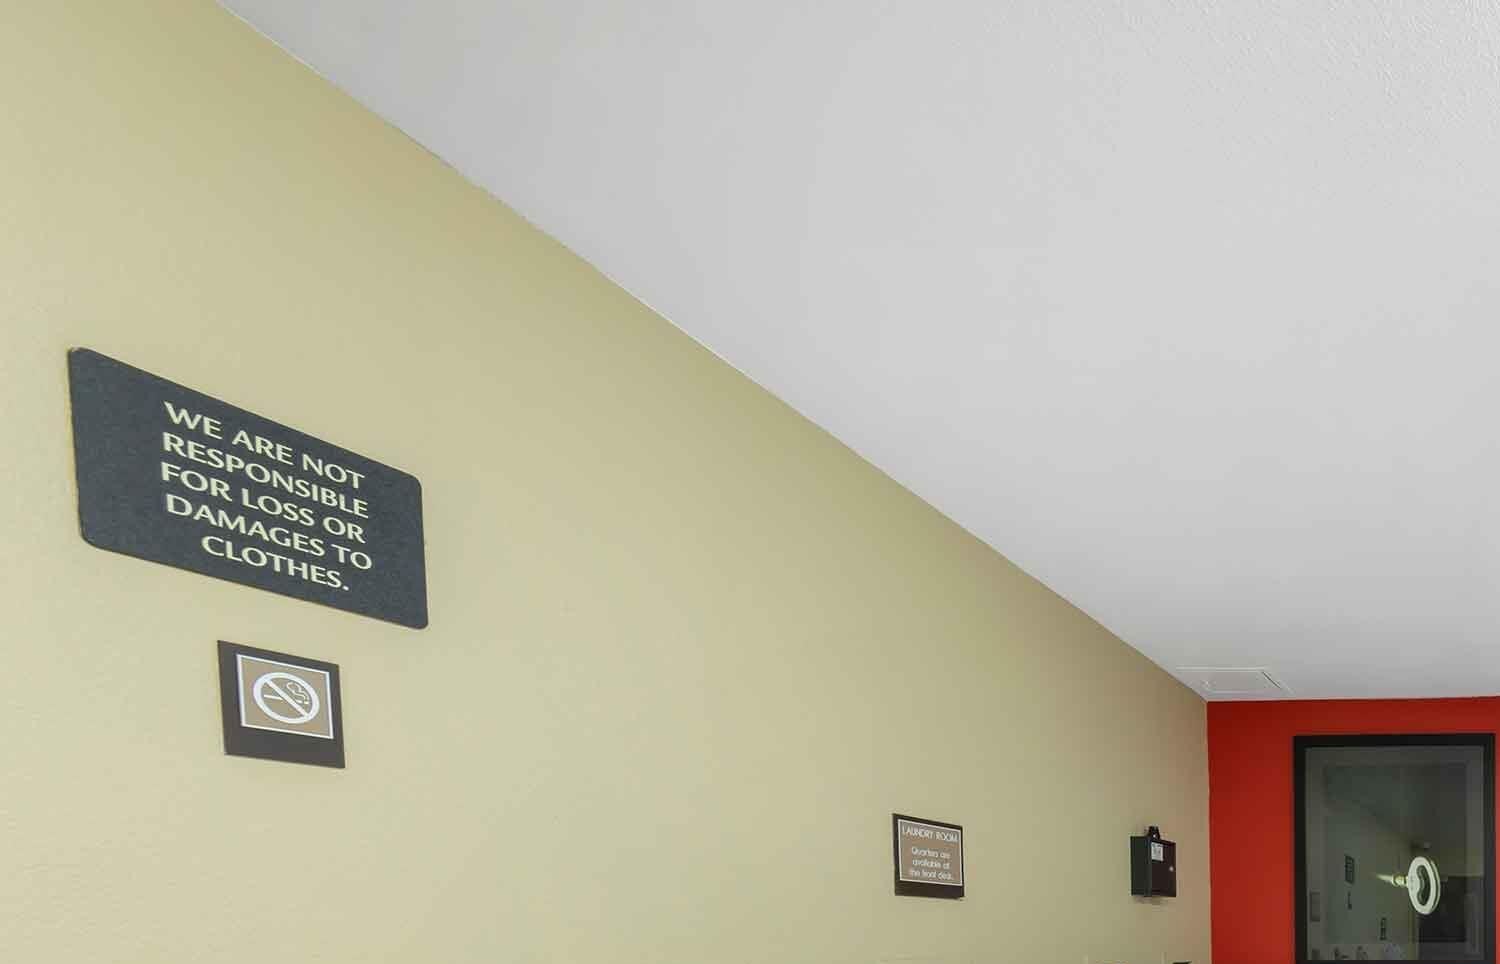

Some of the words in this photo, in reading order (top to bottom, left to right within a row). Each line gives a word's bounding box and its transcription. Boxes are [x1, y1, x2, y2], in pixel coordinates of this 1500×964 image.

[162, 432, 369, 518] RESPONSIBLE
[163, 401, 223, 440] WE
[232, 430, 293, 465] ARE
[303, 453, 364, 489] NOT
[161, 462, 232, 501] FOR
[242, 488, 314, 527] LOSS
[324, 516, 364, 544] OR
[166, 494, 324, 557] DAMAGES
[331, 544, 372, 570] TO
[202, 536, 349, 590] CLOTHES.
[902, 825, 933, 840] LAUNDRY
[935, 832, 959, 843] ROOM
